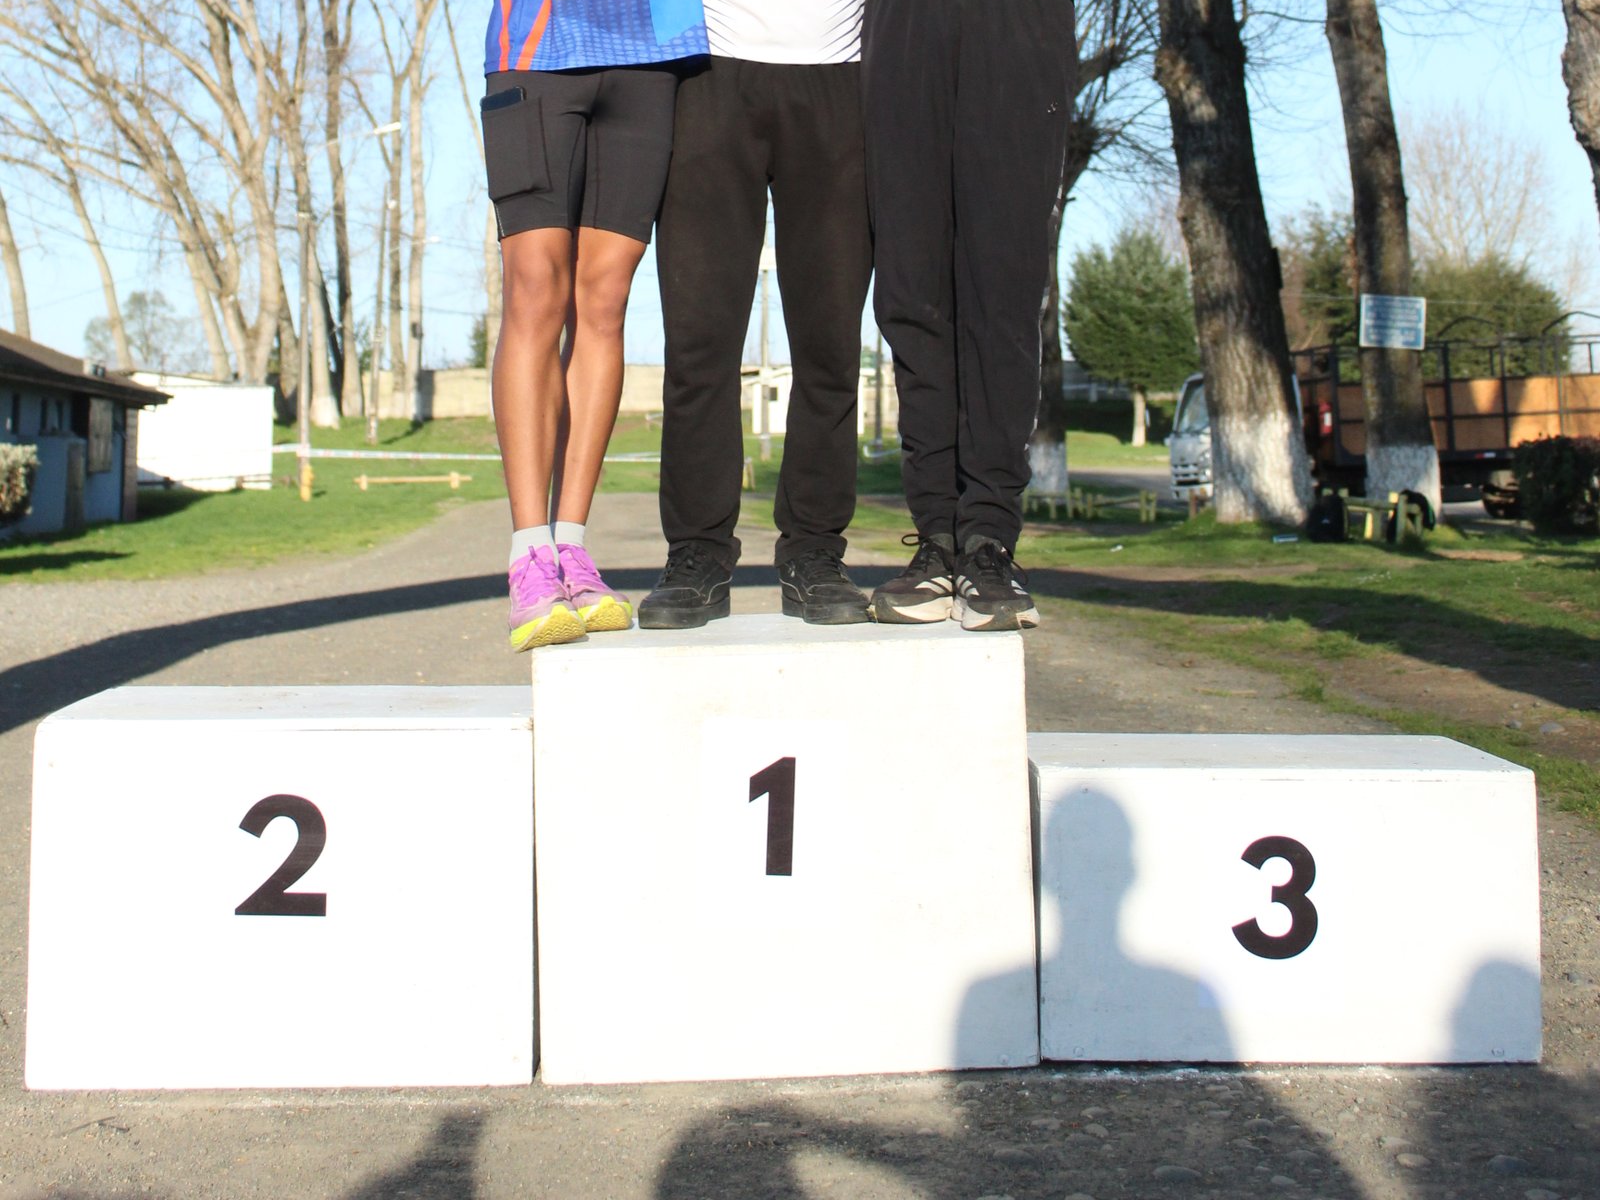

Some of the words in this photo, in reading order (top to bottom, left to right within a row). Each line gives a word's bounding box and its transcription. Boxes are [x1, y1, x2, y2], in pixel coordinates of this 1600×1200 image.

[234, 795, 327, 917] 2
[749, 757, 796, 877] 1
[1232, 836, 1318, 960] 3
